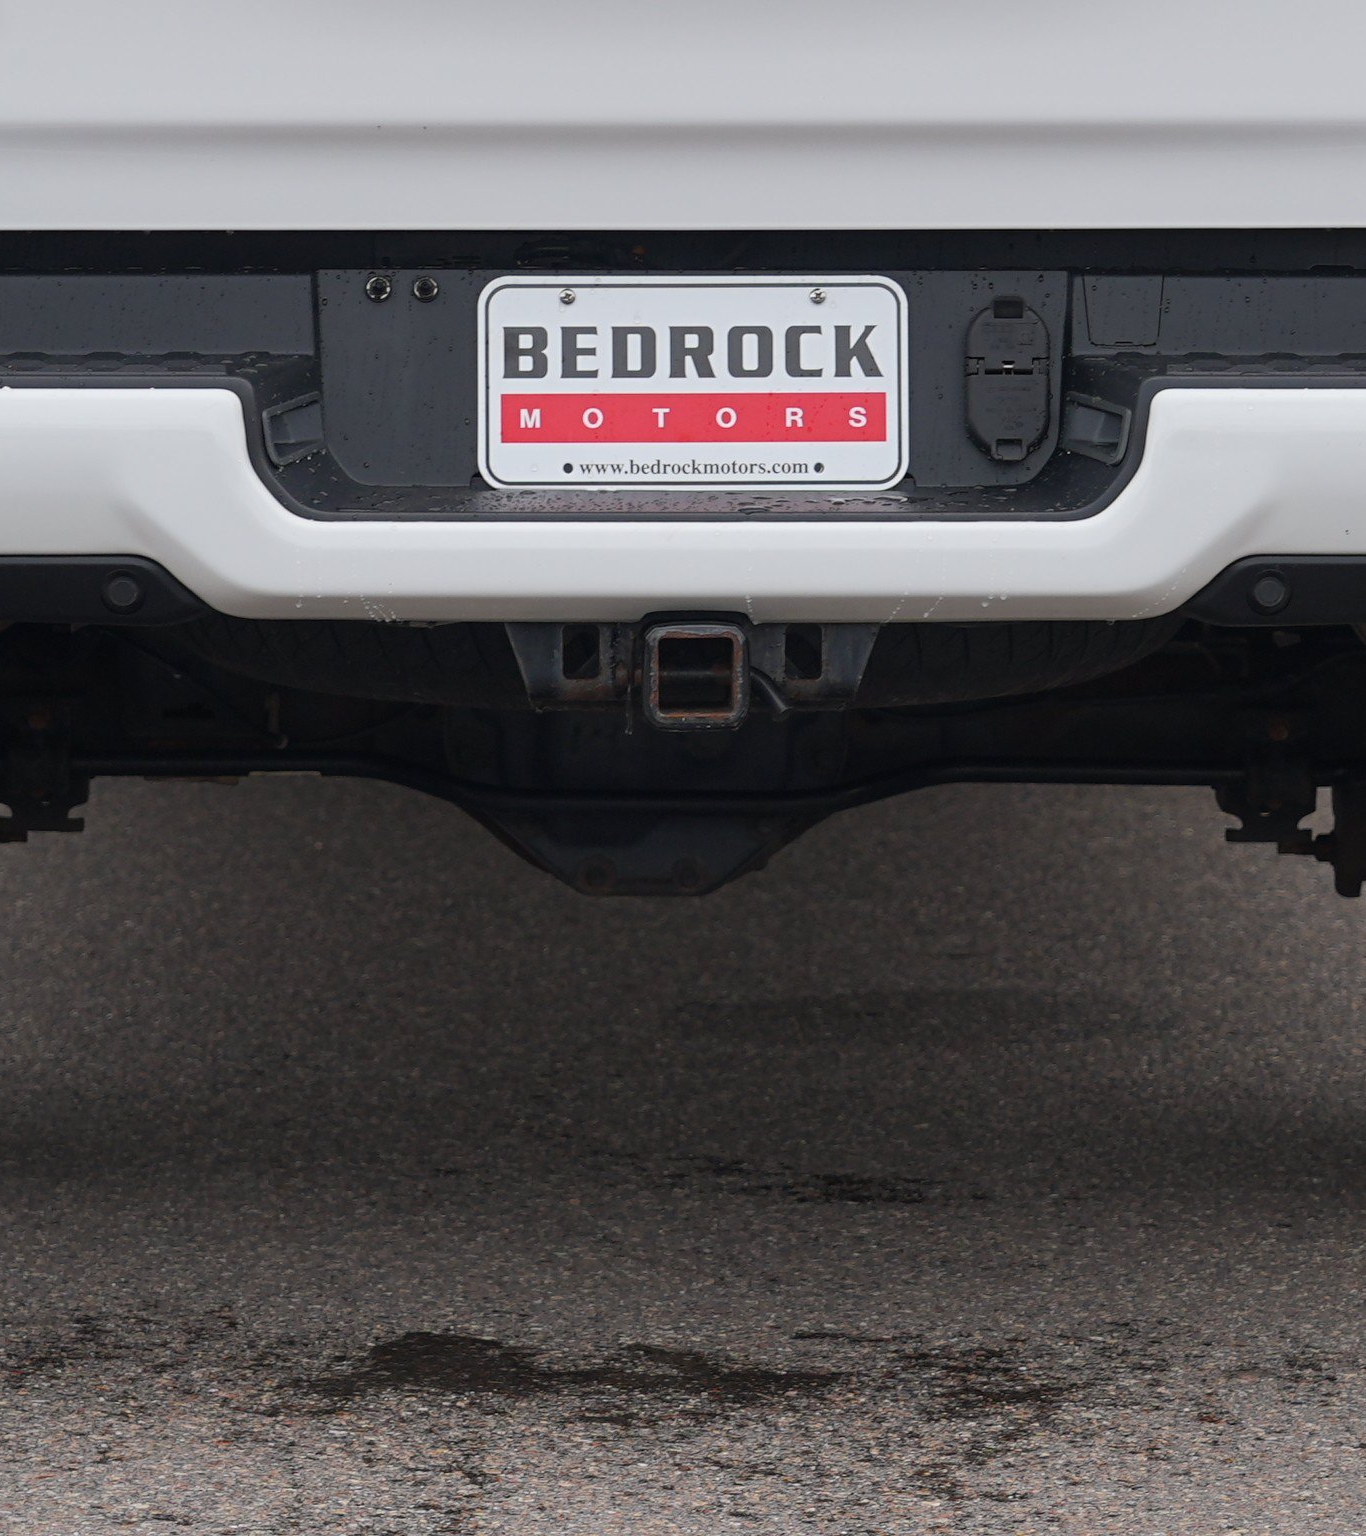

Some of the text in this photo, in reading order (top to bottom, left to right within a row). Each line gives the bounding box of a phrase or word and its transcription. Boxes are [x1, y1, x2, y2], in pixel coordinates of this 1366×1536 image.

[501, 324, 885, 380] BEDROCK
[519, 406, 869, 430] MOTORS
[579, 458, 810, 477] www.bedrockmotors.com
